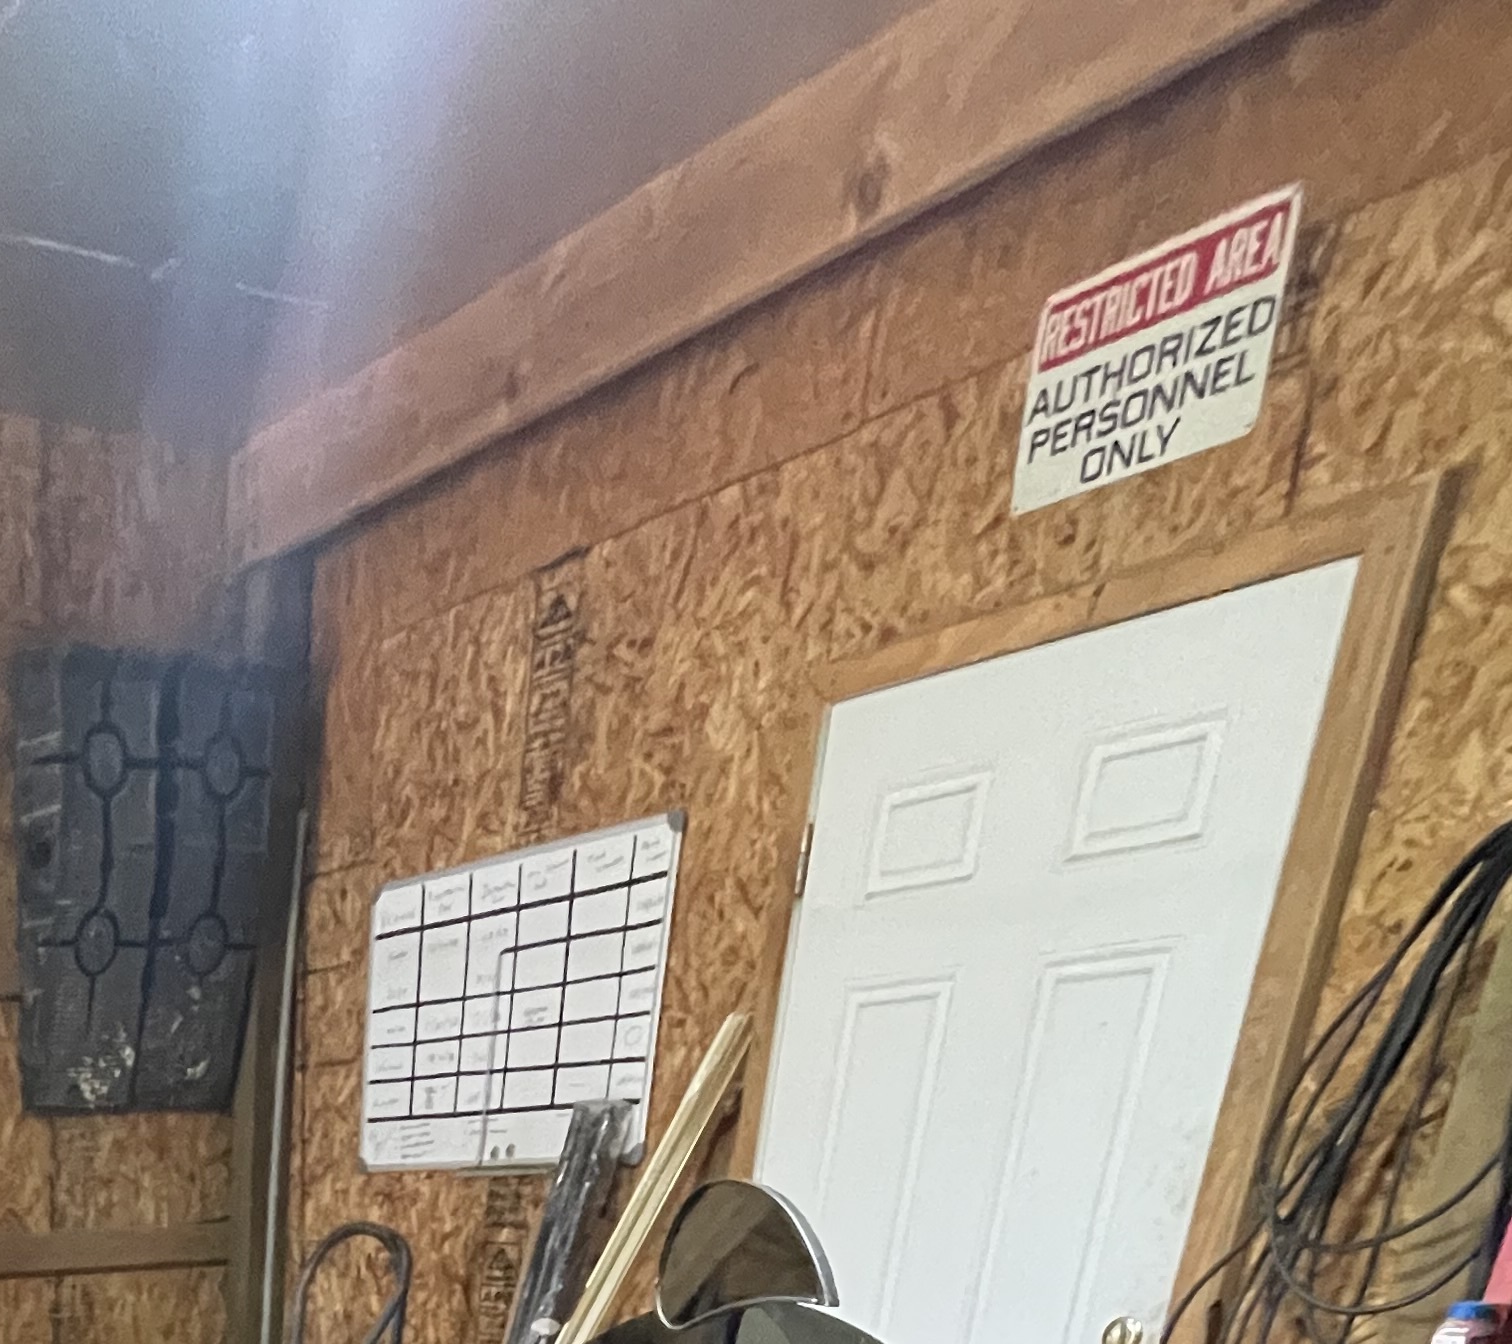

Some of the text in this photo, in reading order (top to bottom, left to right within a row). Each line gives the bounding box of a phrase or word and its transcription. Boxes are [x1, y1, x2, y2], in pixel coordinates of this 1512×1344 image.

[1041, 212, 1284, 360] RESTRICTED AREA
[1027, 296, 1276, 426] AUTHORIZED
[1028, 350, 1255, 464] PERSONNEL
[1080, 418, 1181, 484] ONLY
